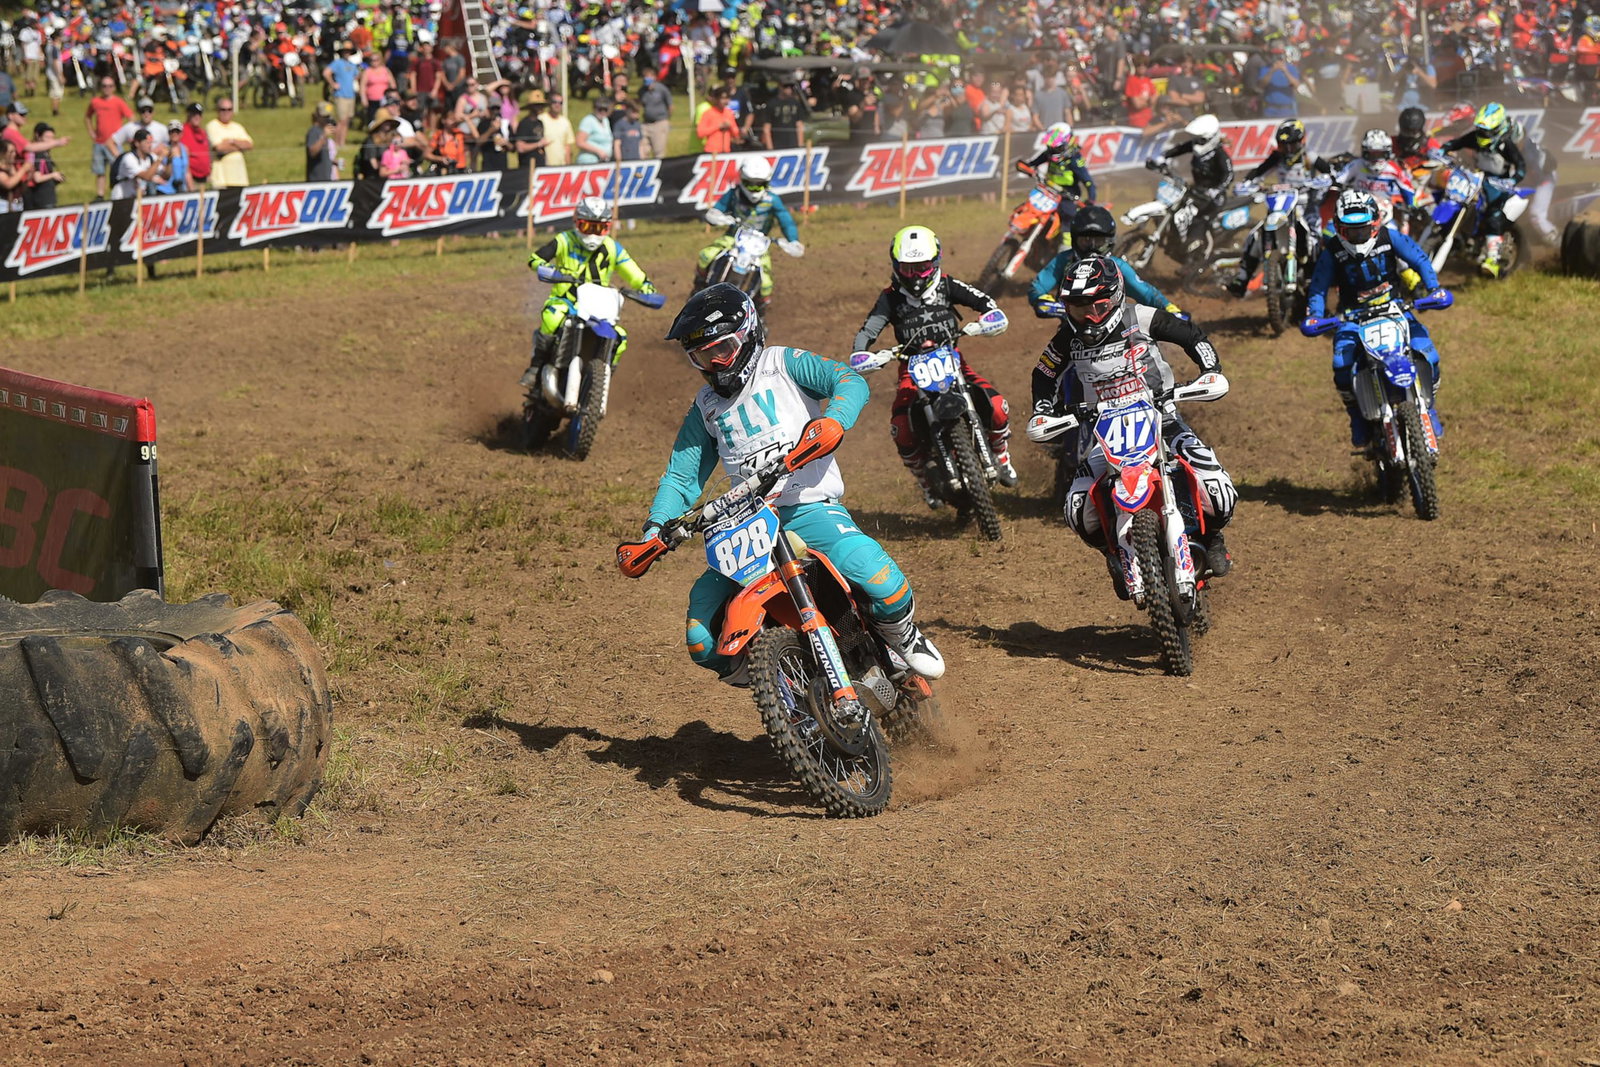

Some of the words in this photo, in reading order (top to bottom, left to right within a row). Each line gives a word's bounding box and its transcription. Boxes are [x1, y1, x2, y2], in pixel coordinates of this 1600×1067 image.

[856, 141, 995, 191] AMSOIL
[1220, 122, 1358, 167] AMOIL
[530, 165, 657, 217] AMSOIL
[689, 153, 825, 203] AMOIL
[236, 188, 348, 240] AMSOIL
[377, 178, 497, 230] AMSOIL
[913, 354, 959, 388] 904
[715, 388, 780, 449] FLY
[1103, 409, 1155, 454] 417
[714, 518, 772, 577] 828
[722, 628, 749, 649] KTM
[810, 633, 840, 689] DUNLOP
